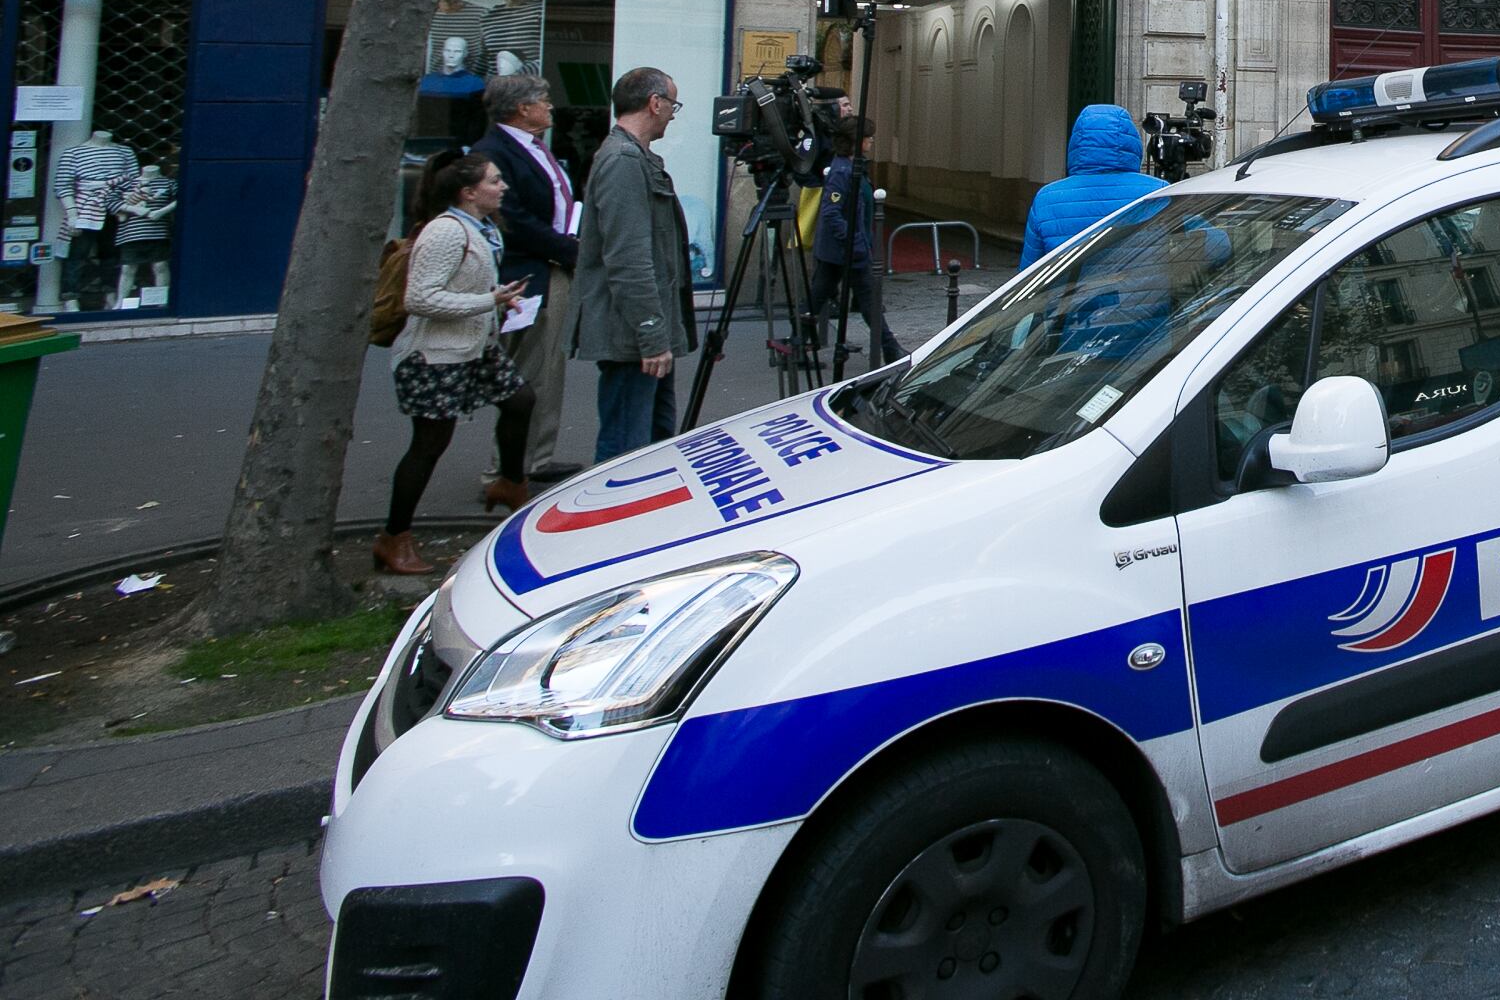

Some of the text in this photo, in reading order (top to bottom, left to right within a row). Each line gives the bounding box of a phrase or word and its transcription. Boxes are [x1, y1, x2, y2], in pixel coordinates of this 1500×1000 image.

[750, 413, 842, 467] POLICE
[675, 428, 785, 522] NATIONALE
[1132, 544, 1178, 561] Gruau
